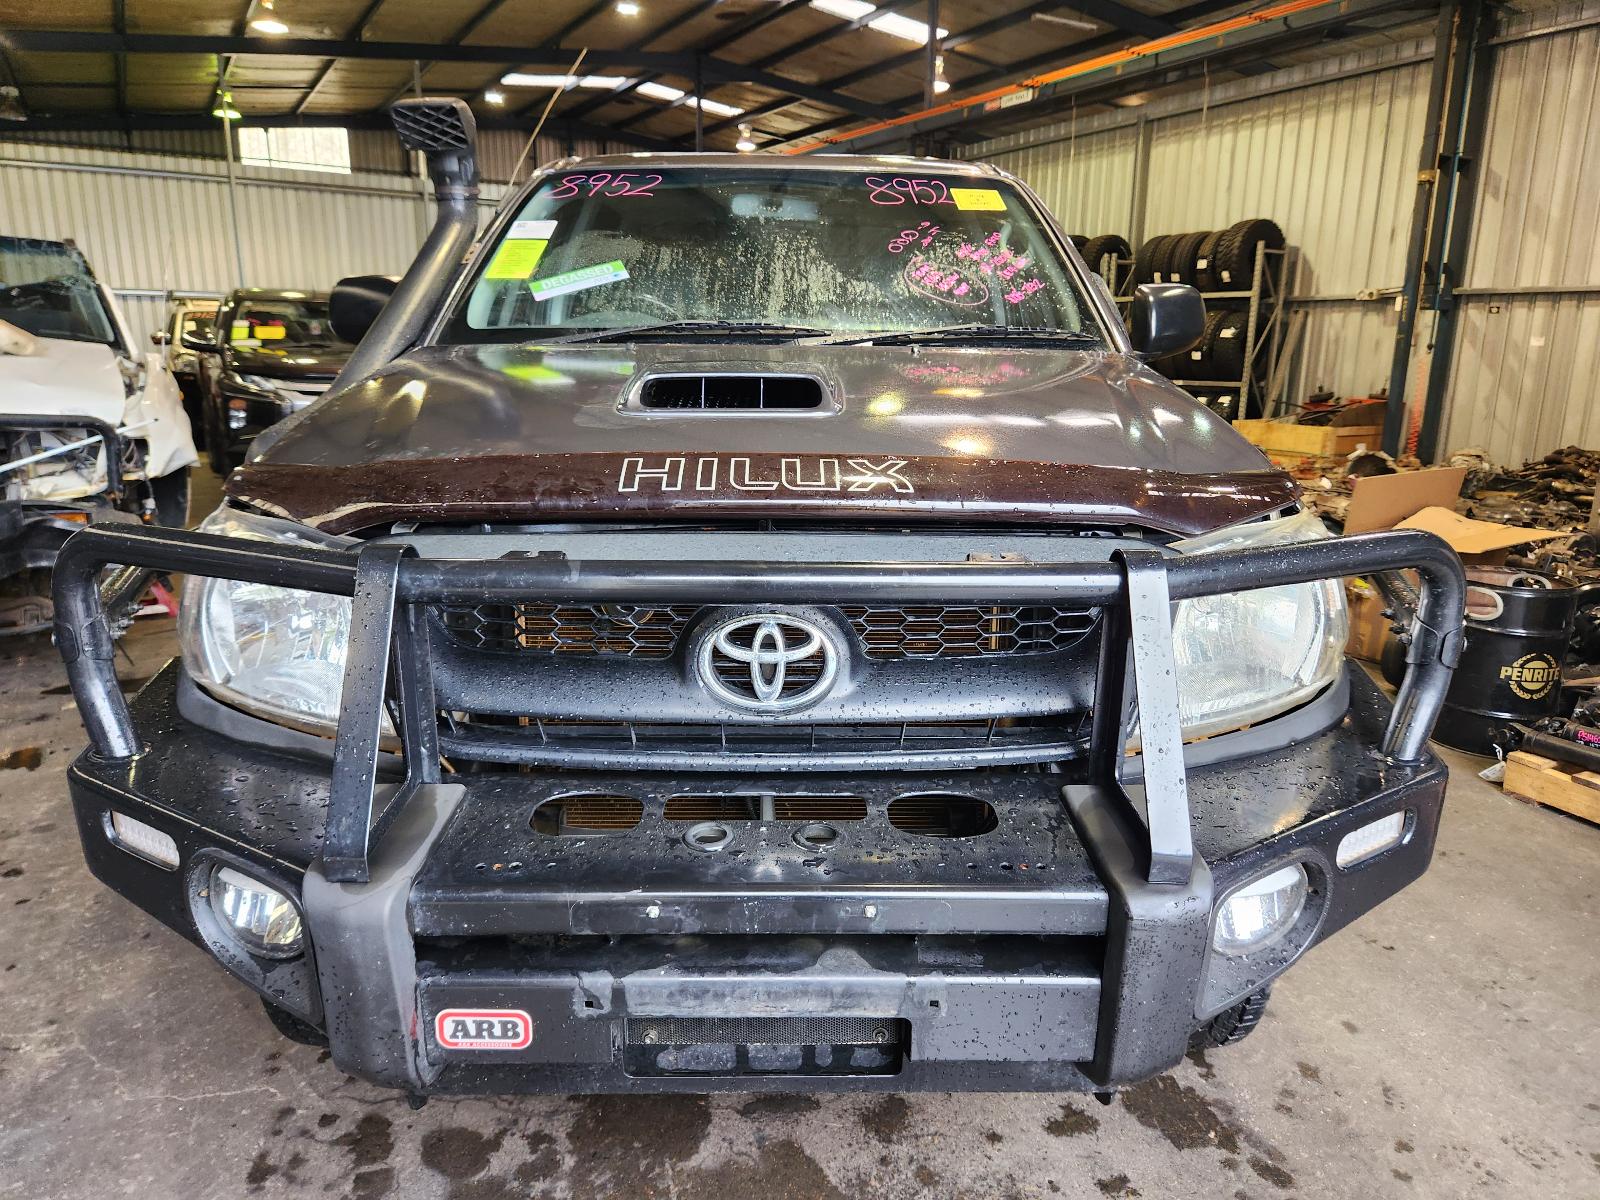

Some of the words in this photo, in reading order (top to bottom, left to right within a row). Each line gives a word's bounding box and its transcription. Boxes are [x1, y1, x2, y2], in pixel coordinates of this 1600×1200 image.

[543, 173, 663, 199] 8952
[865, 176, 955, 205] 8952
[542, 264, 614, 290] DEGASSED
[617, 457, 915, 493] HILUX
[1499, 666, 1560, 683] PENRITE
[449, 1019, 521, 1040] ARB
